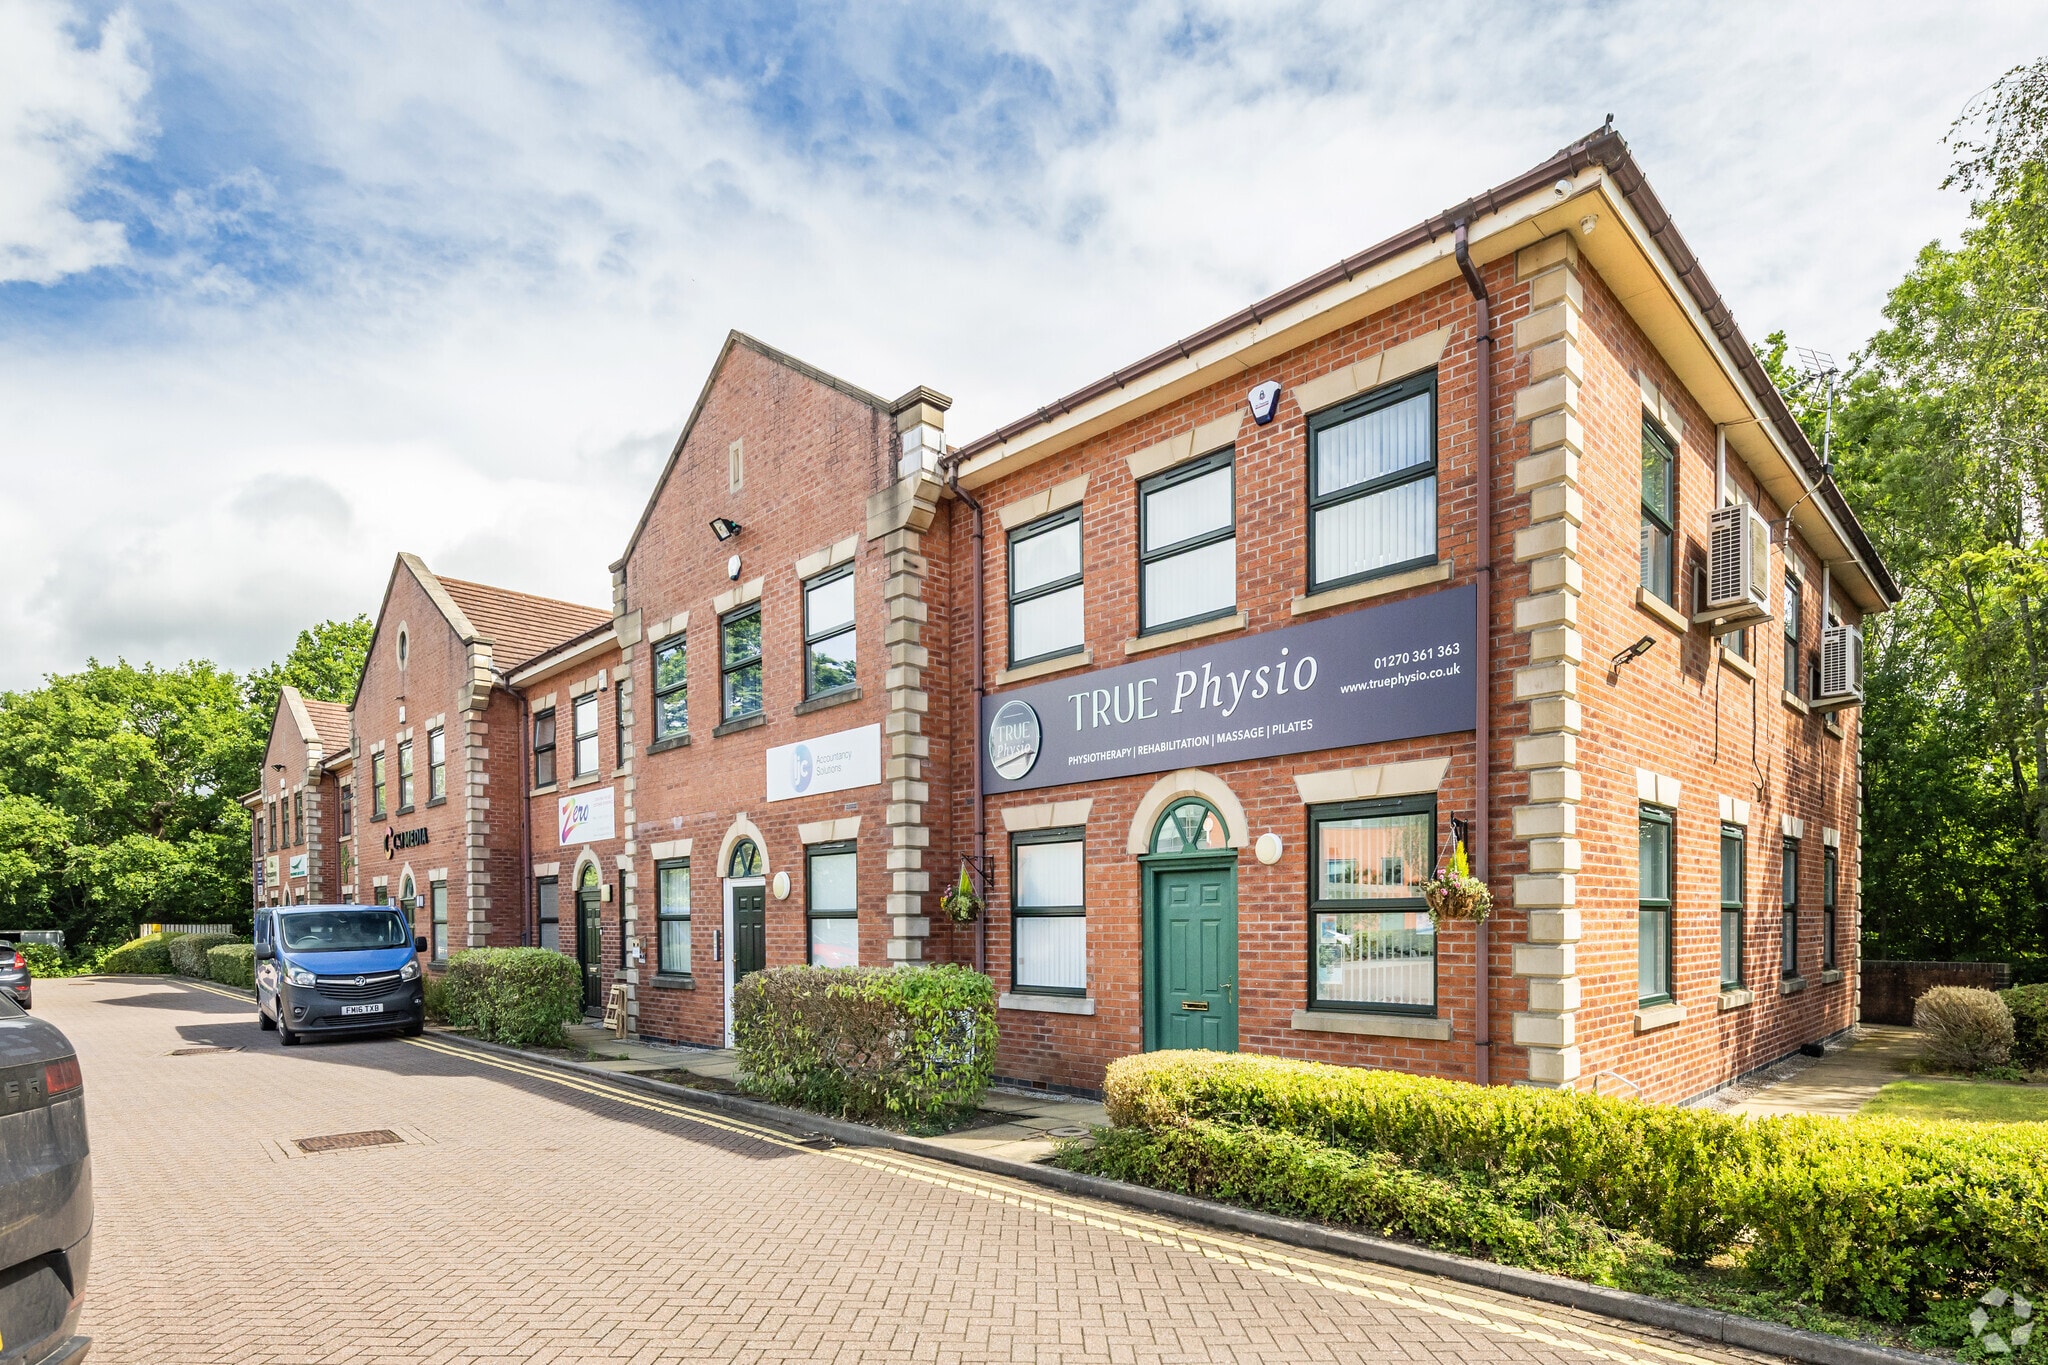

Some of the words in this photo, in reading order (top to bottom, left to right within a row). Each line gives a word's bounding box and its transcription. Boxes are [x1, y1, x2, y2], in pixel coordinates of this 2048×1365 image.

[1374, 657, 1410, 670] 01270
[1412, 648, 1433, 662] 361
[1437, 642, 1460, 658] 363
[1068, 678, 1158, 731] TRUE
[1171, 647, 1318, 717] Physio
[1340, 663, 1461, 694] www.truephysio.co.uk
[996, 721, 1031, 742] TRUE
[1068, 747, 1132, 766] PHYSIOTHERAPY
[1137, 735, 1210, 756] REHABILITATION
[1216, 726, 1265, 743] MASSAGE
[1272, 719, 1314, 735] PILATES
[816, 751, 852, 764] Accountancy
[997, 741, 1032, 758] Physio
[816, 765, 842, 776] Solutions
[562, 798, 589, 843] Zero
[364, 1004, 379, 1012] TXB
